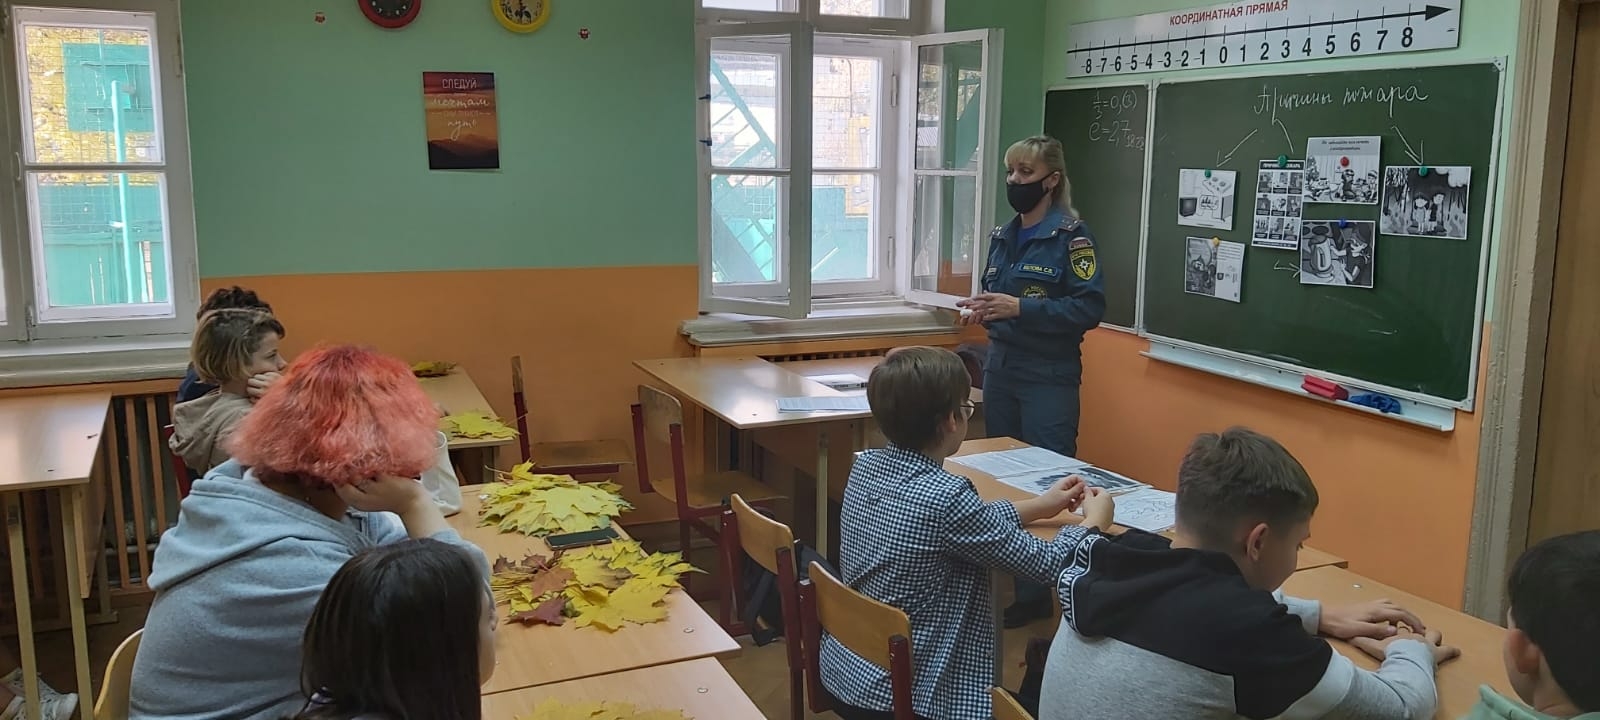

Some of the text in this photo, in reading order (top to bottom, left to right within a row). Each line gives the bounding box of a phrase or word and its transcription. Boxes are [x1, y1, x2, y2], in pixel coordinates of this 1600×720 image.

[1169, 1, 1288, 26] КООРДИНАТНАЯ ПРЯМАЯ
[1219, 46, 1228, 64] 0
[1239, 45, 1246, 62] 1
[1260, 43, 1269, 60] 2
[1281, 40, 1290, 58] 3
[1302, 38, 1312, 56] 4
[1325, 35, 1336, 54] 5
[1350, 32, 1360, 52] 6
[1376, 30, 1388, 50] 7
[1401, 27, 1413, 48] 8
